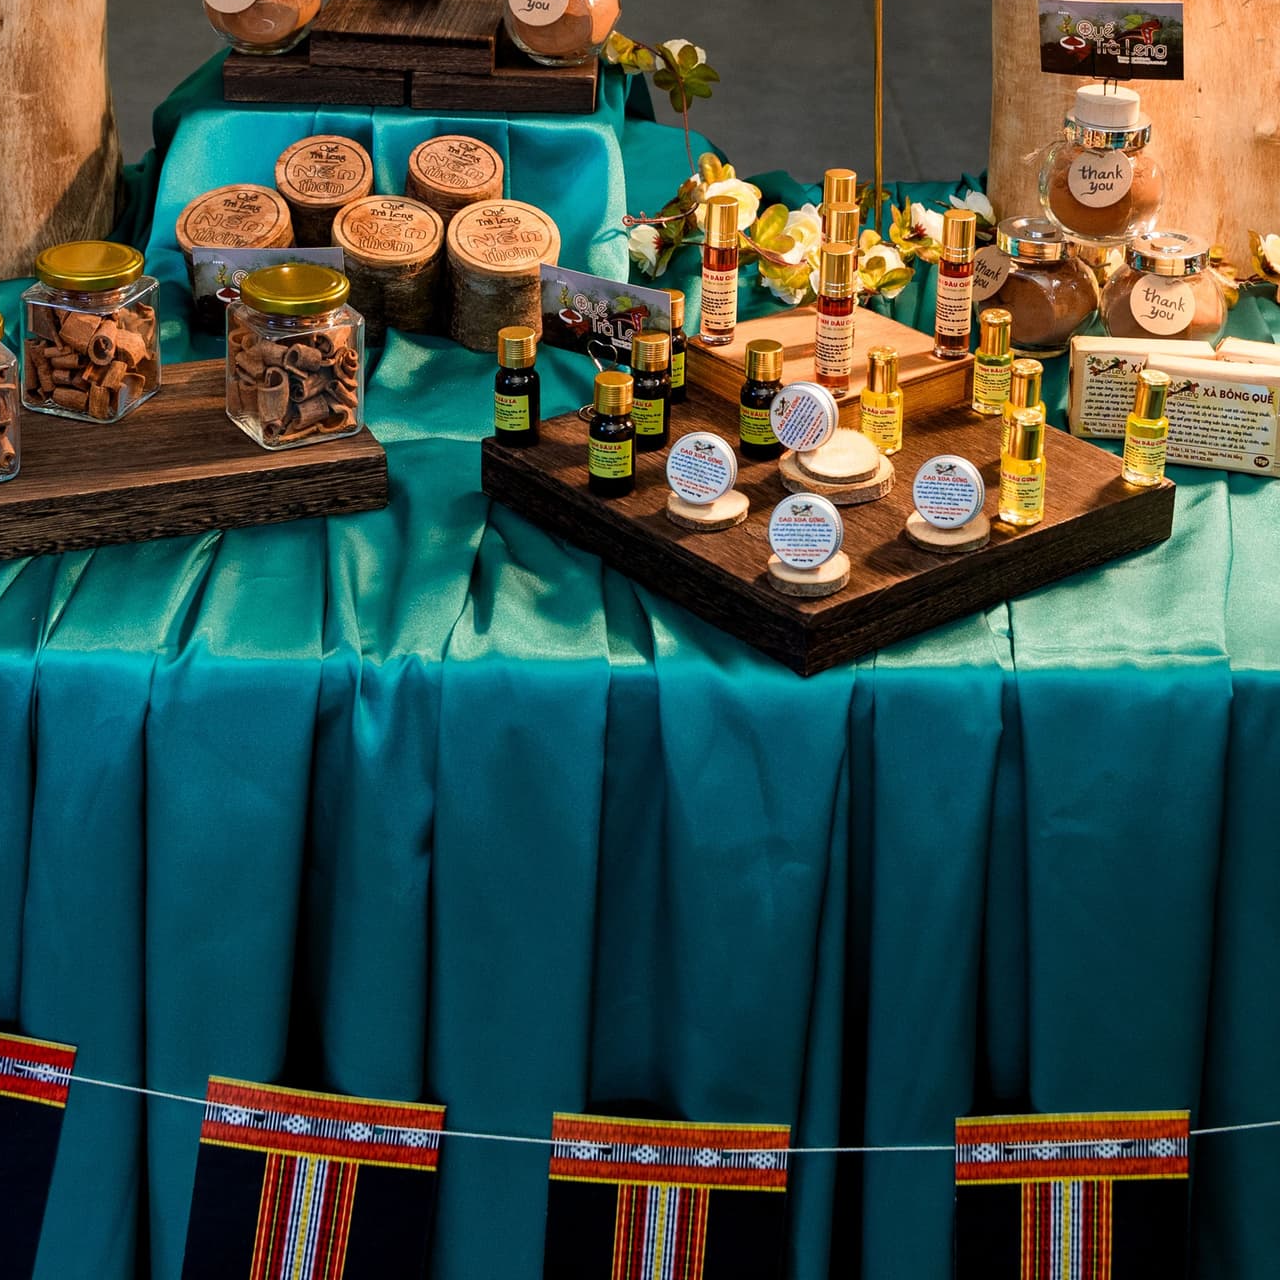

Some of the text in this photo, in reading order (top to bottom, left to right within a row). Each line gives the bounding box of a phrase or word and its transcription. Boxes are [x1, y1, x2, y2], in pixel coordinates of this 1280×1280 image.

[1076, 20, 1116, 41] Quế
[1095, 37, 1121, 56] Trà
[1078, 164, 1123, 180] thank
[1080, 181, 1114, 196] you
[974, 258, 1002, 281] thank
[973, 276, 990, 290] you
[573, 293, 610, 319] Quế
[1142, 287, 1186, 313] thank
[1140, 306, 1175, 321] you
[586, 314, 615, 337] Trà
[1219, 388, 1250, 402] BÔNG
[1251, 391, 1275, 405] QUẾ
